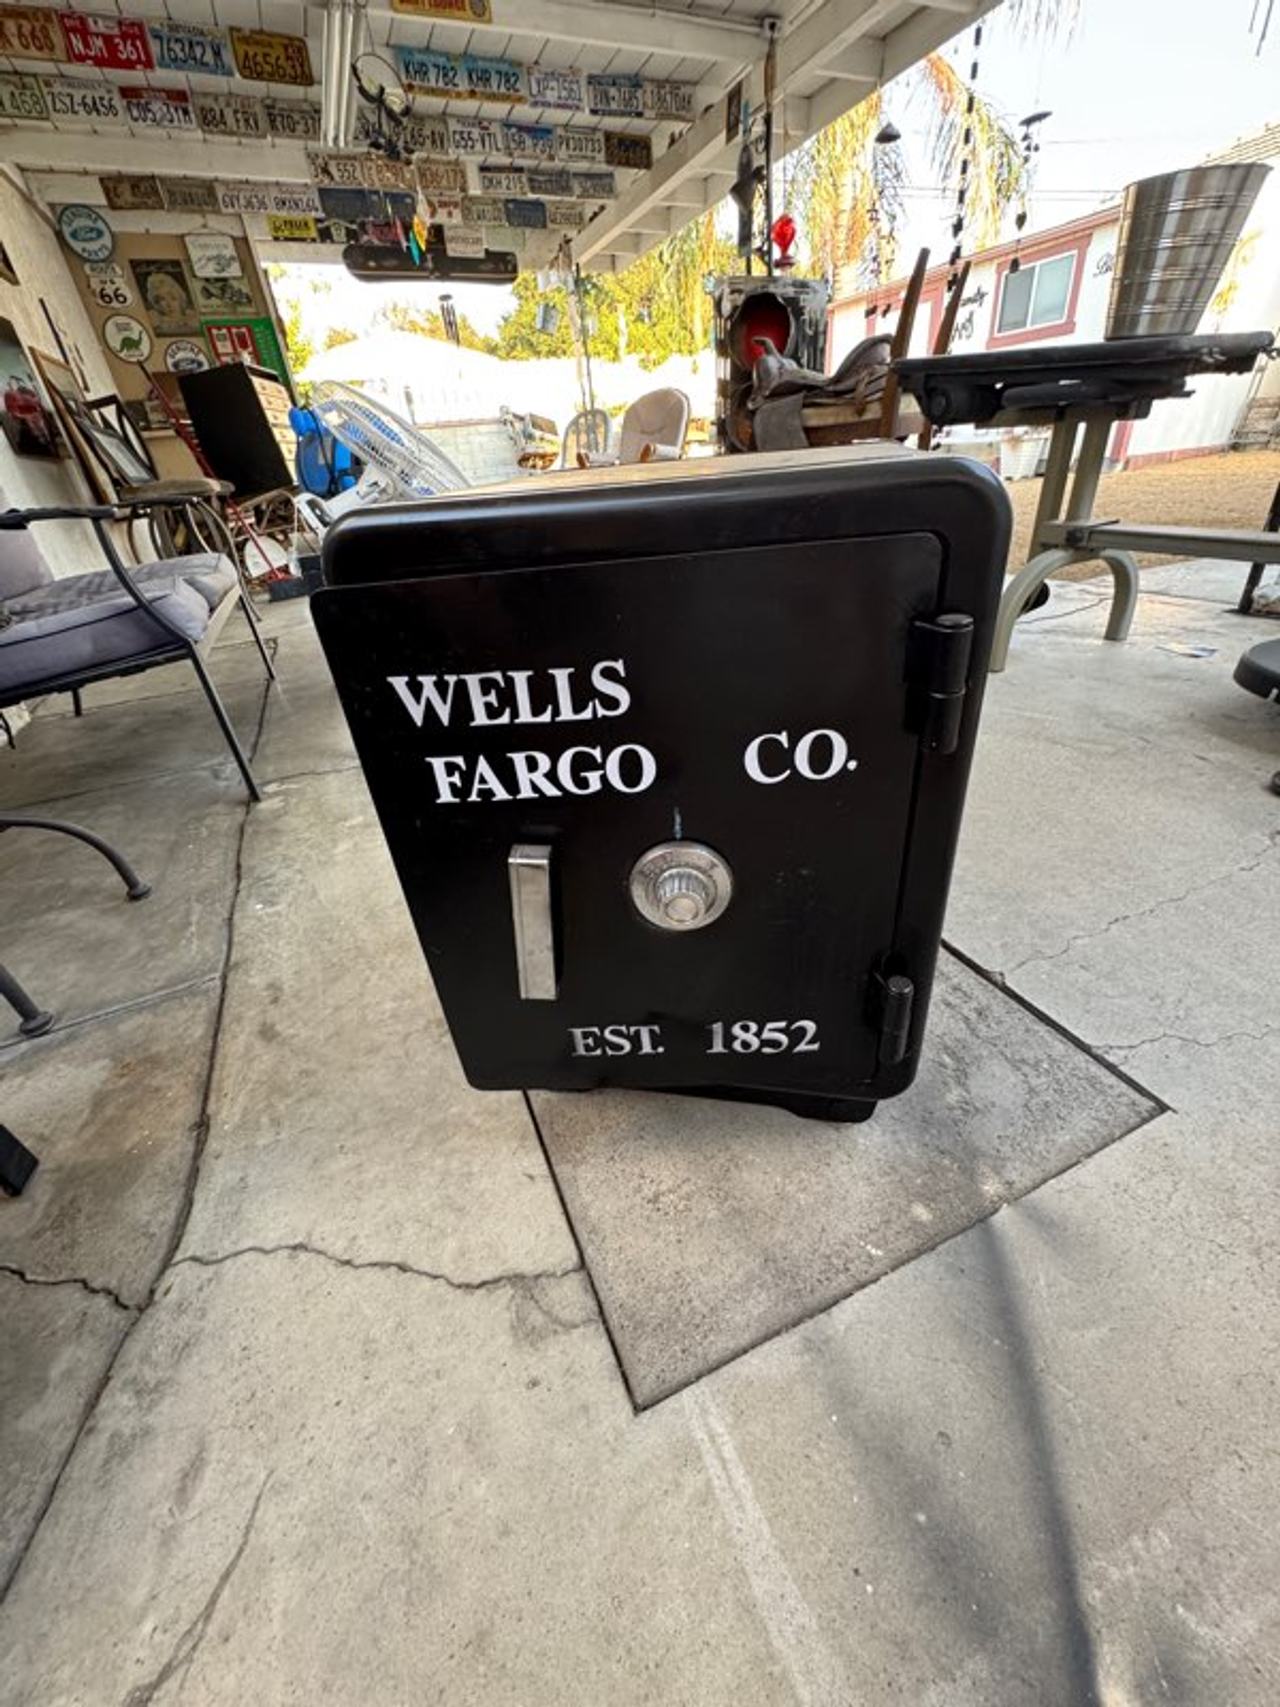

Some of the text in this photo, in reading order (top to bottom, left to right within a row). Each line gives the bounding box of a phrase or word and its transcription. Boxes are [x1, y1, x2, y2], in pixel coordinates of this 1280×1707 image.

[115, 38, 146, 61] 361
[402, 59, 460, 88] KHR 782
[495, 70, 520, 92] 782
[99, 287, 128, 305] 66
[387, 659, 630, 726] WELLS
[426, 730, 857, 803] FARGO CO.
[568, 1020, 819, 1056] EST. 1852
